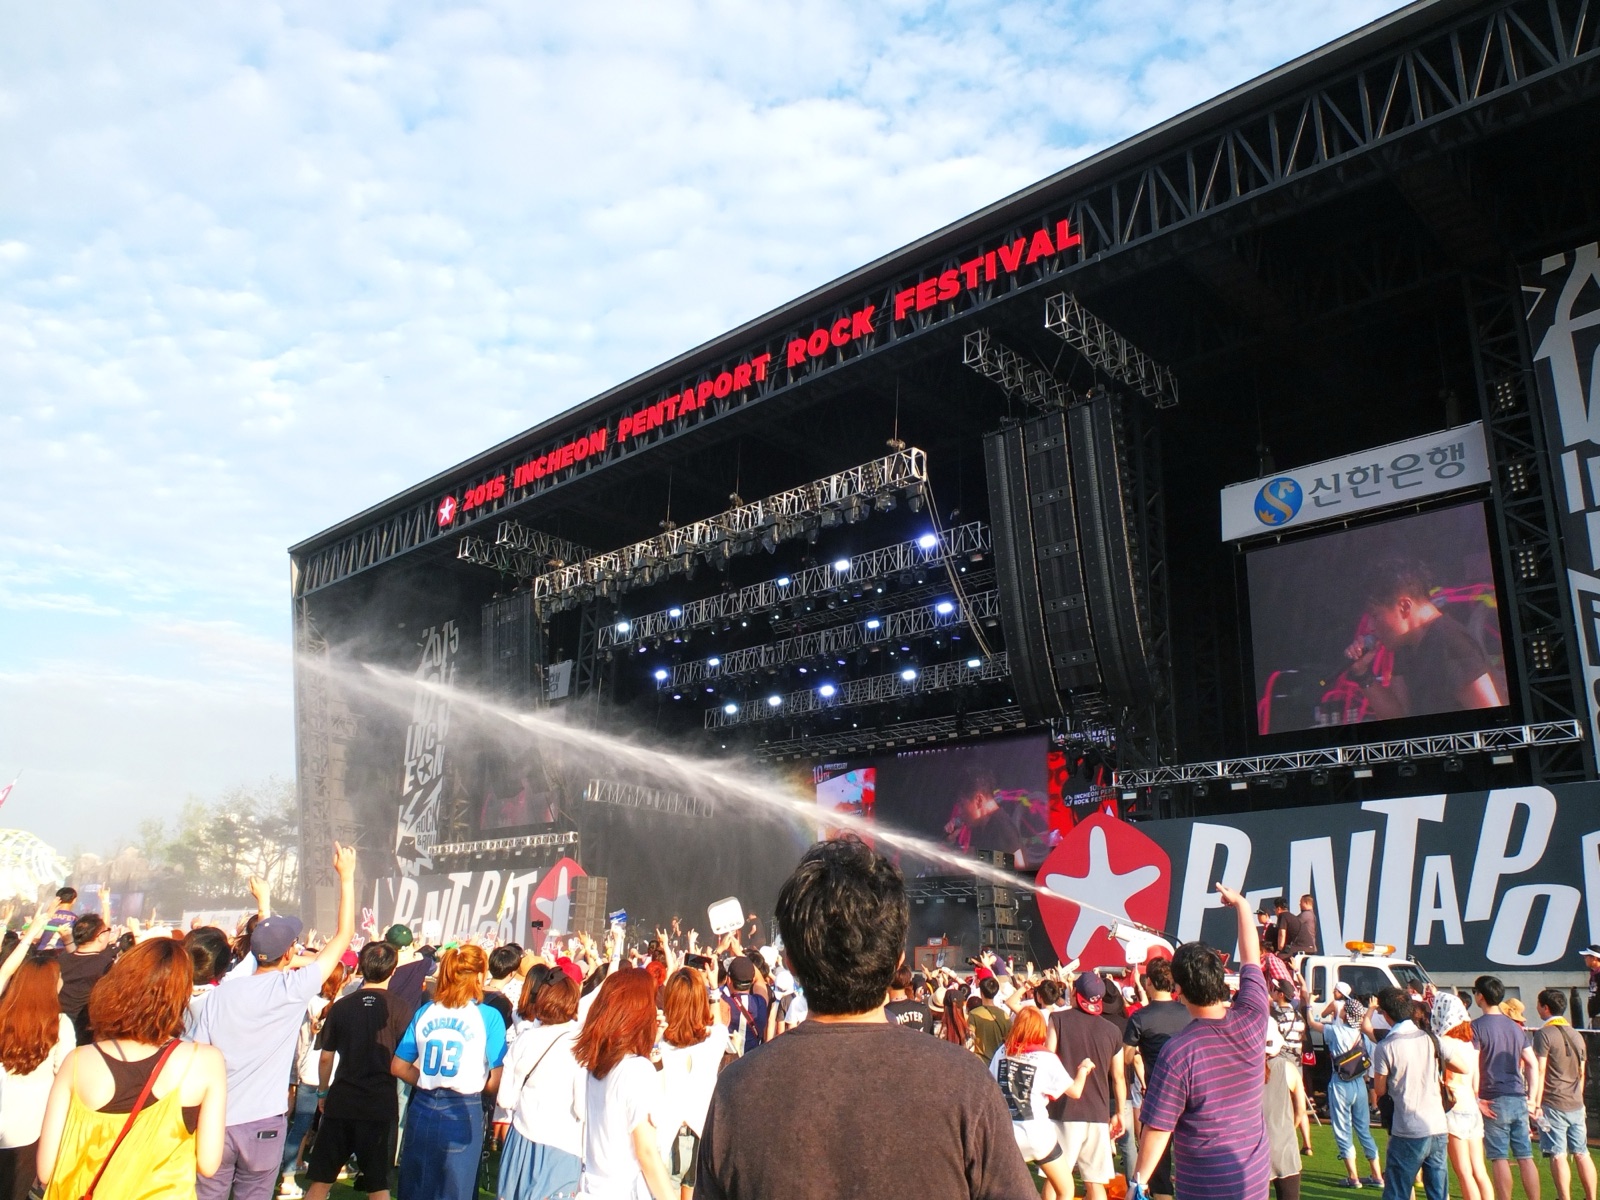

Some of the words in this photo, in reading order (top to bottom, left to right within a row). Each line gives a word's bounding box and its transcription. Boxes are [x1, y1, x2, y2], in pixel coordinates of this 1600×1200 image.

[462, 474, 506, 512] 2015
[513, 428, 607, 489] INCHEON
[617, 352, 771, 443] PENTAPORT
[787, 306, 876, 368] ROCK
[895, 219, 1081, 320] FESTIVAL
[1307, 441, 1466, 508] 신한은행
[1175, 785, 1600, 966] PNTAPO
[422, 1039, 464, 1077] 03
